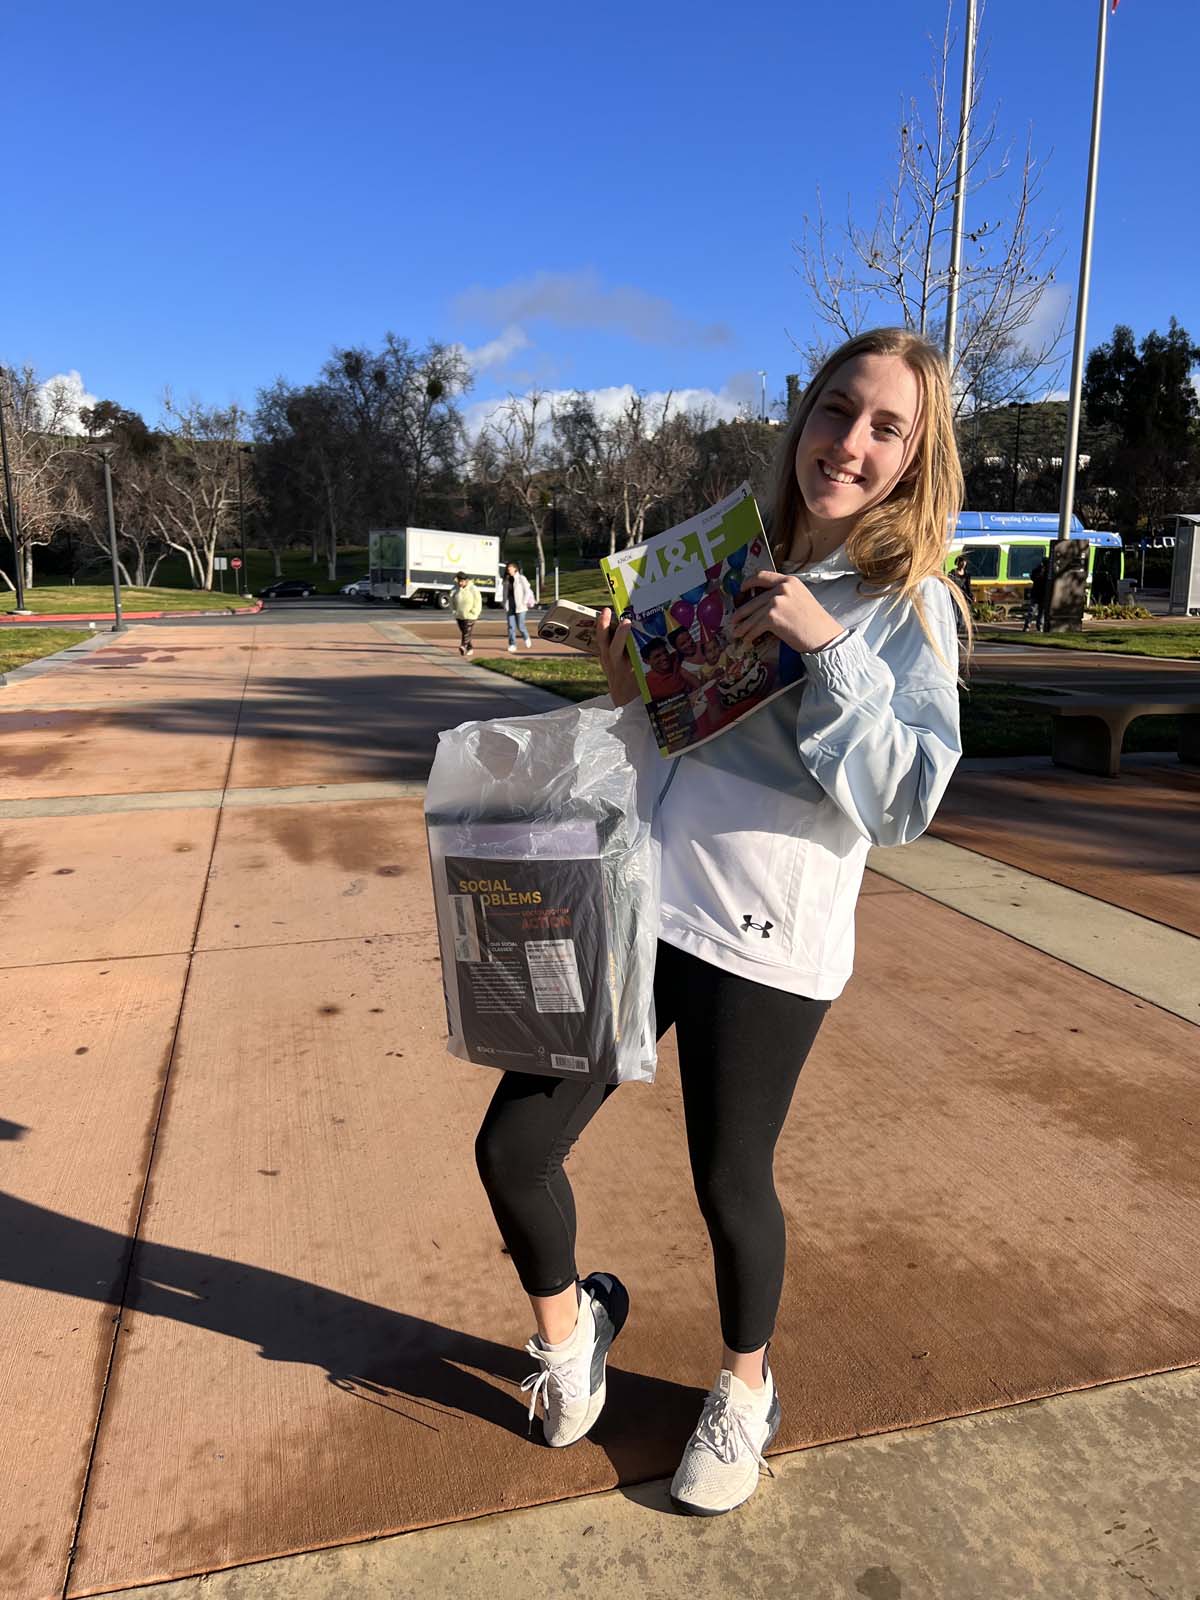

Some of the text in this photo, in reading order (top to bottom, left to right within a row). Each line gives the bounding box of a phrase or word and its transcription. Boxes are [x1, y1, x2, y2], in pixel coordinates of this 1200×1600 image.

[619, 513, 726, 597] M&F
[459, 879, 512, 893] SOCIAL
[482, 890, 542, 906] OBLEMS
